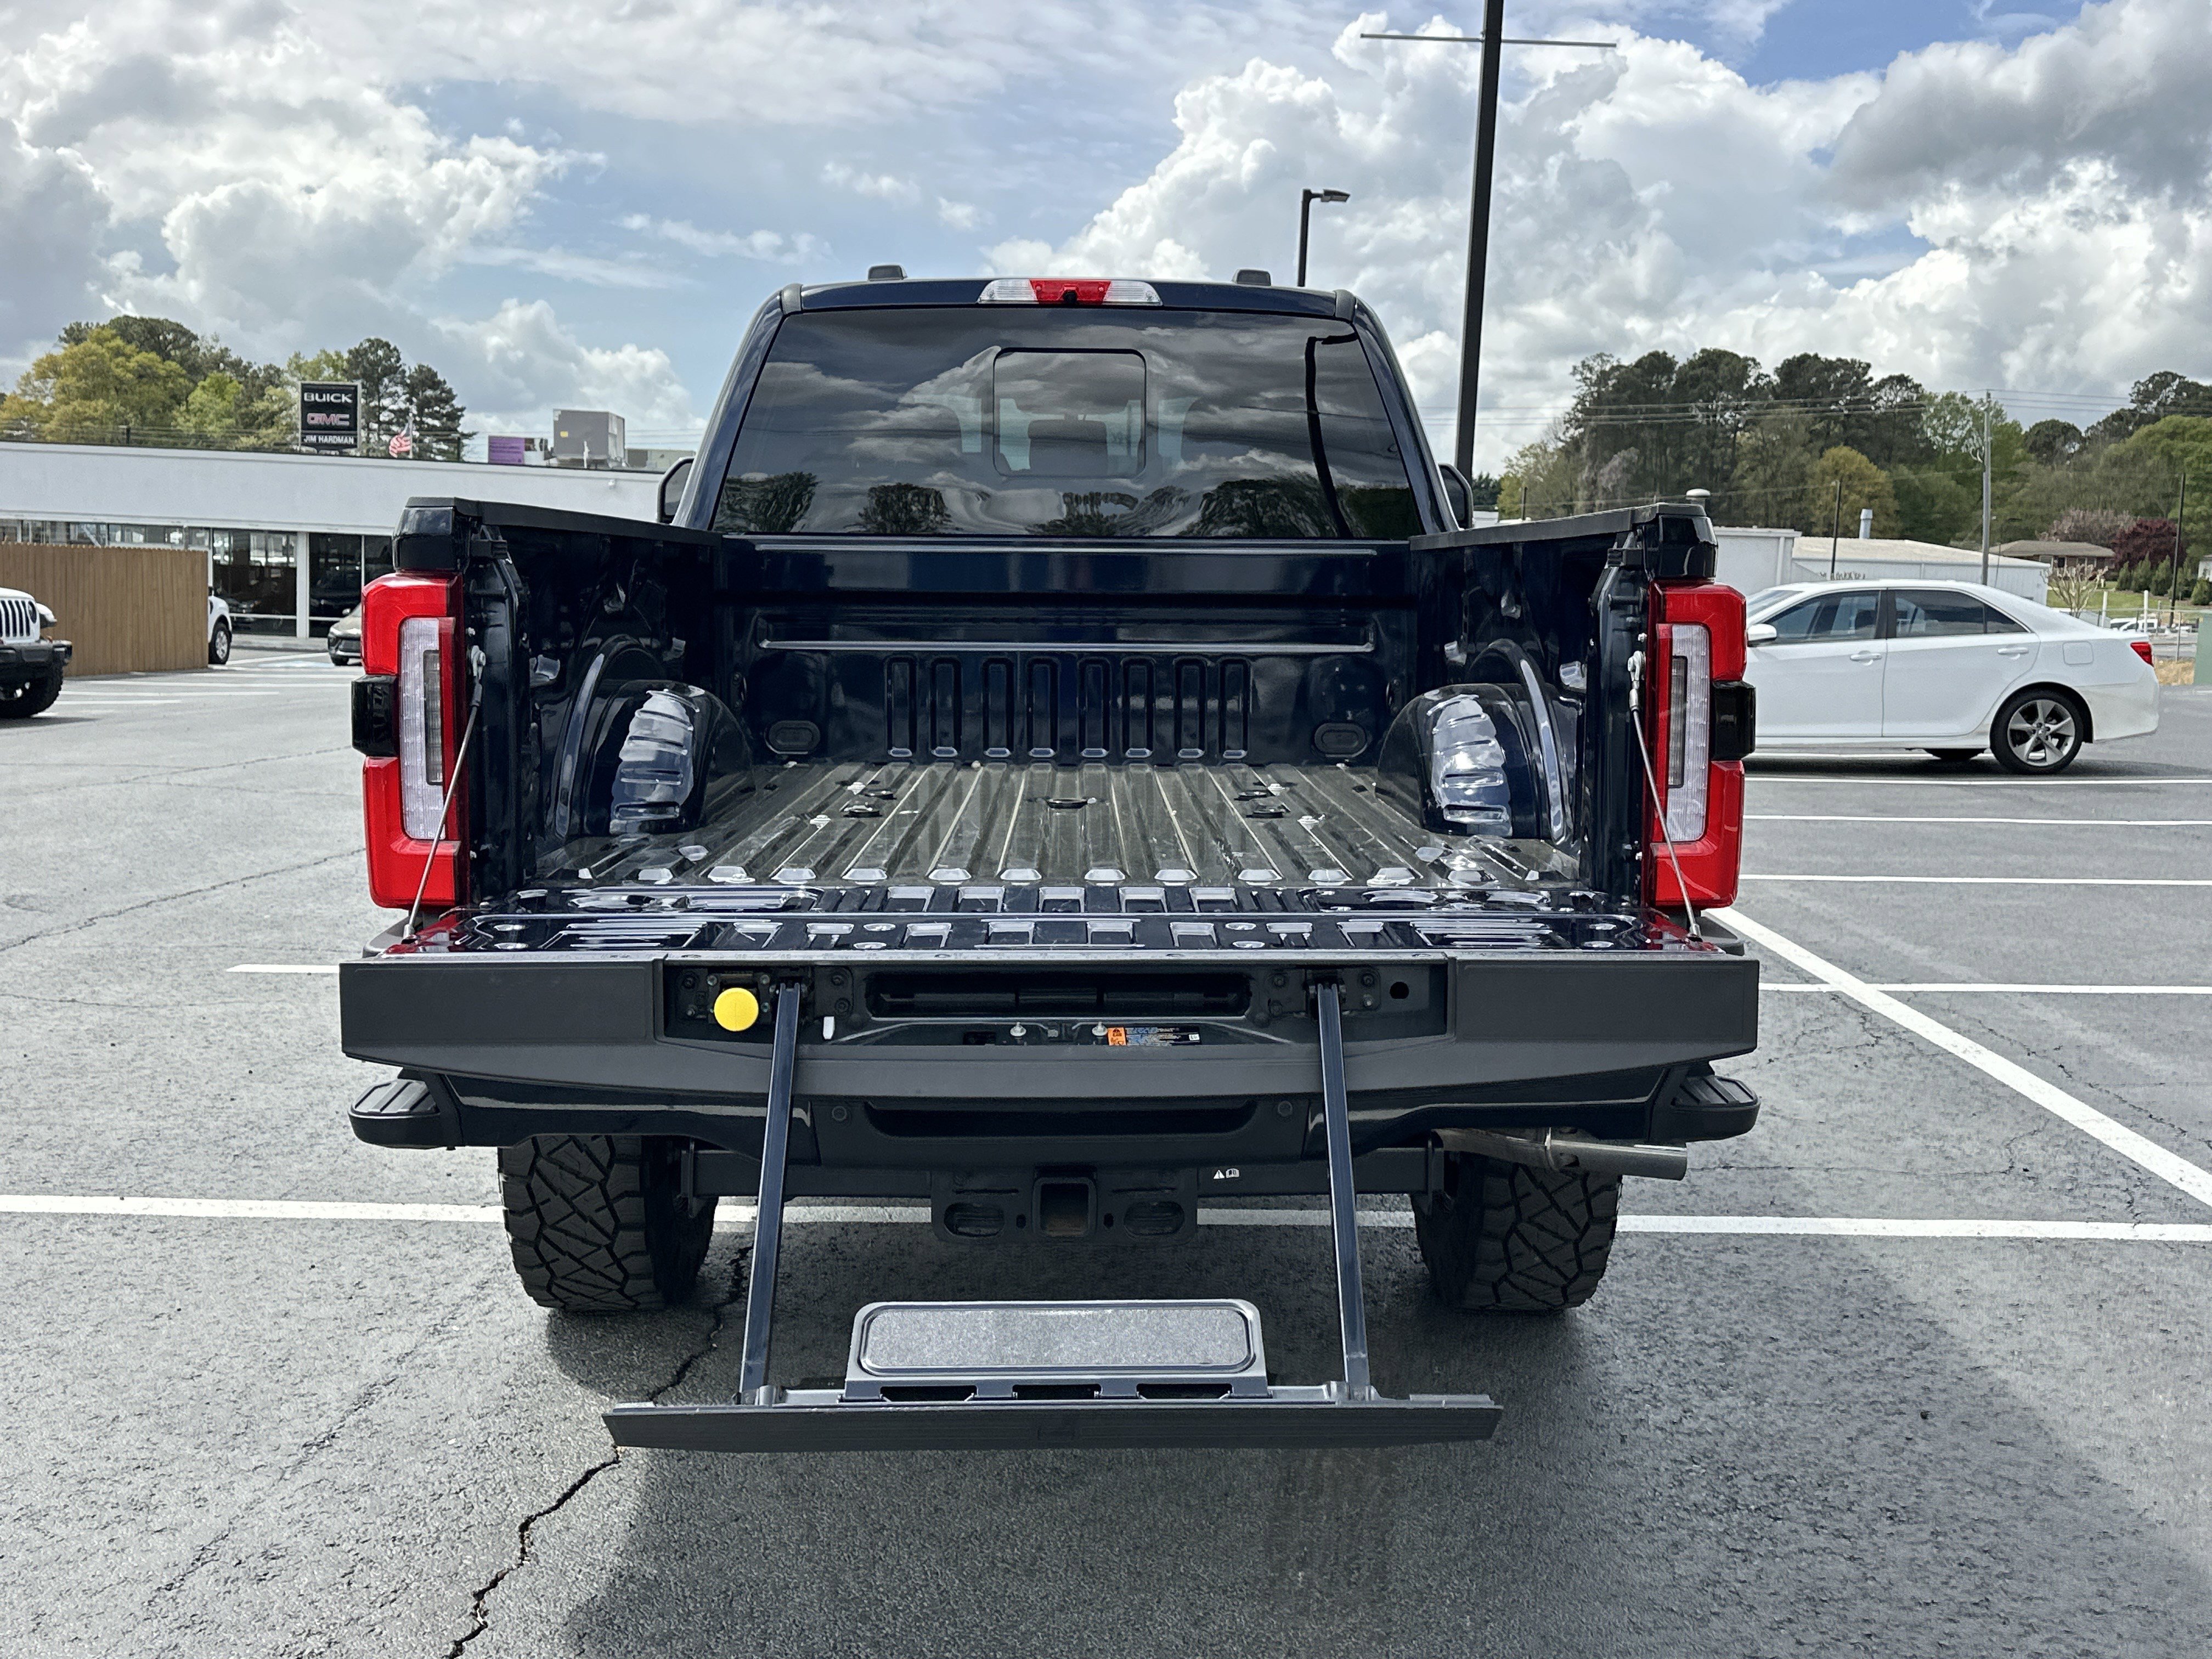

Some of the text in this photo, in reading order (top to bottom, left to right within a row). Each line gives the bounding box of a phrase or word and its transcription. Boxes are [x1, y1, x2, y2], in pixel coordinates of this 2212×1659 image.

[304, 392, 352, 403] BUICK
[307, 413, 349, 426] GMC
[318, 435, 354, 444] HARDMAN
